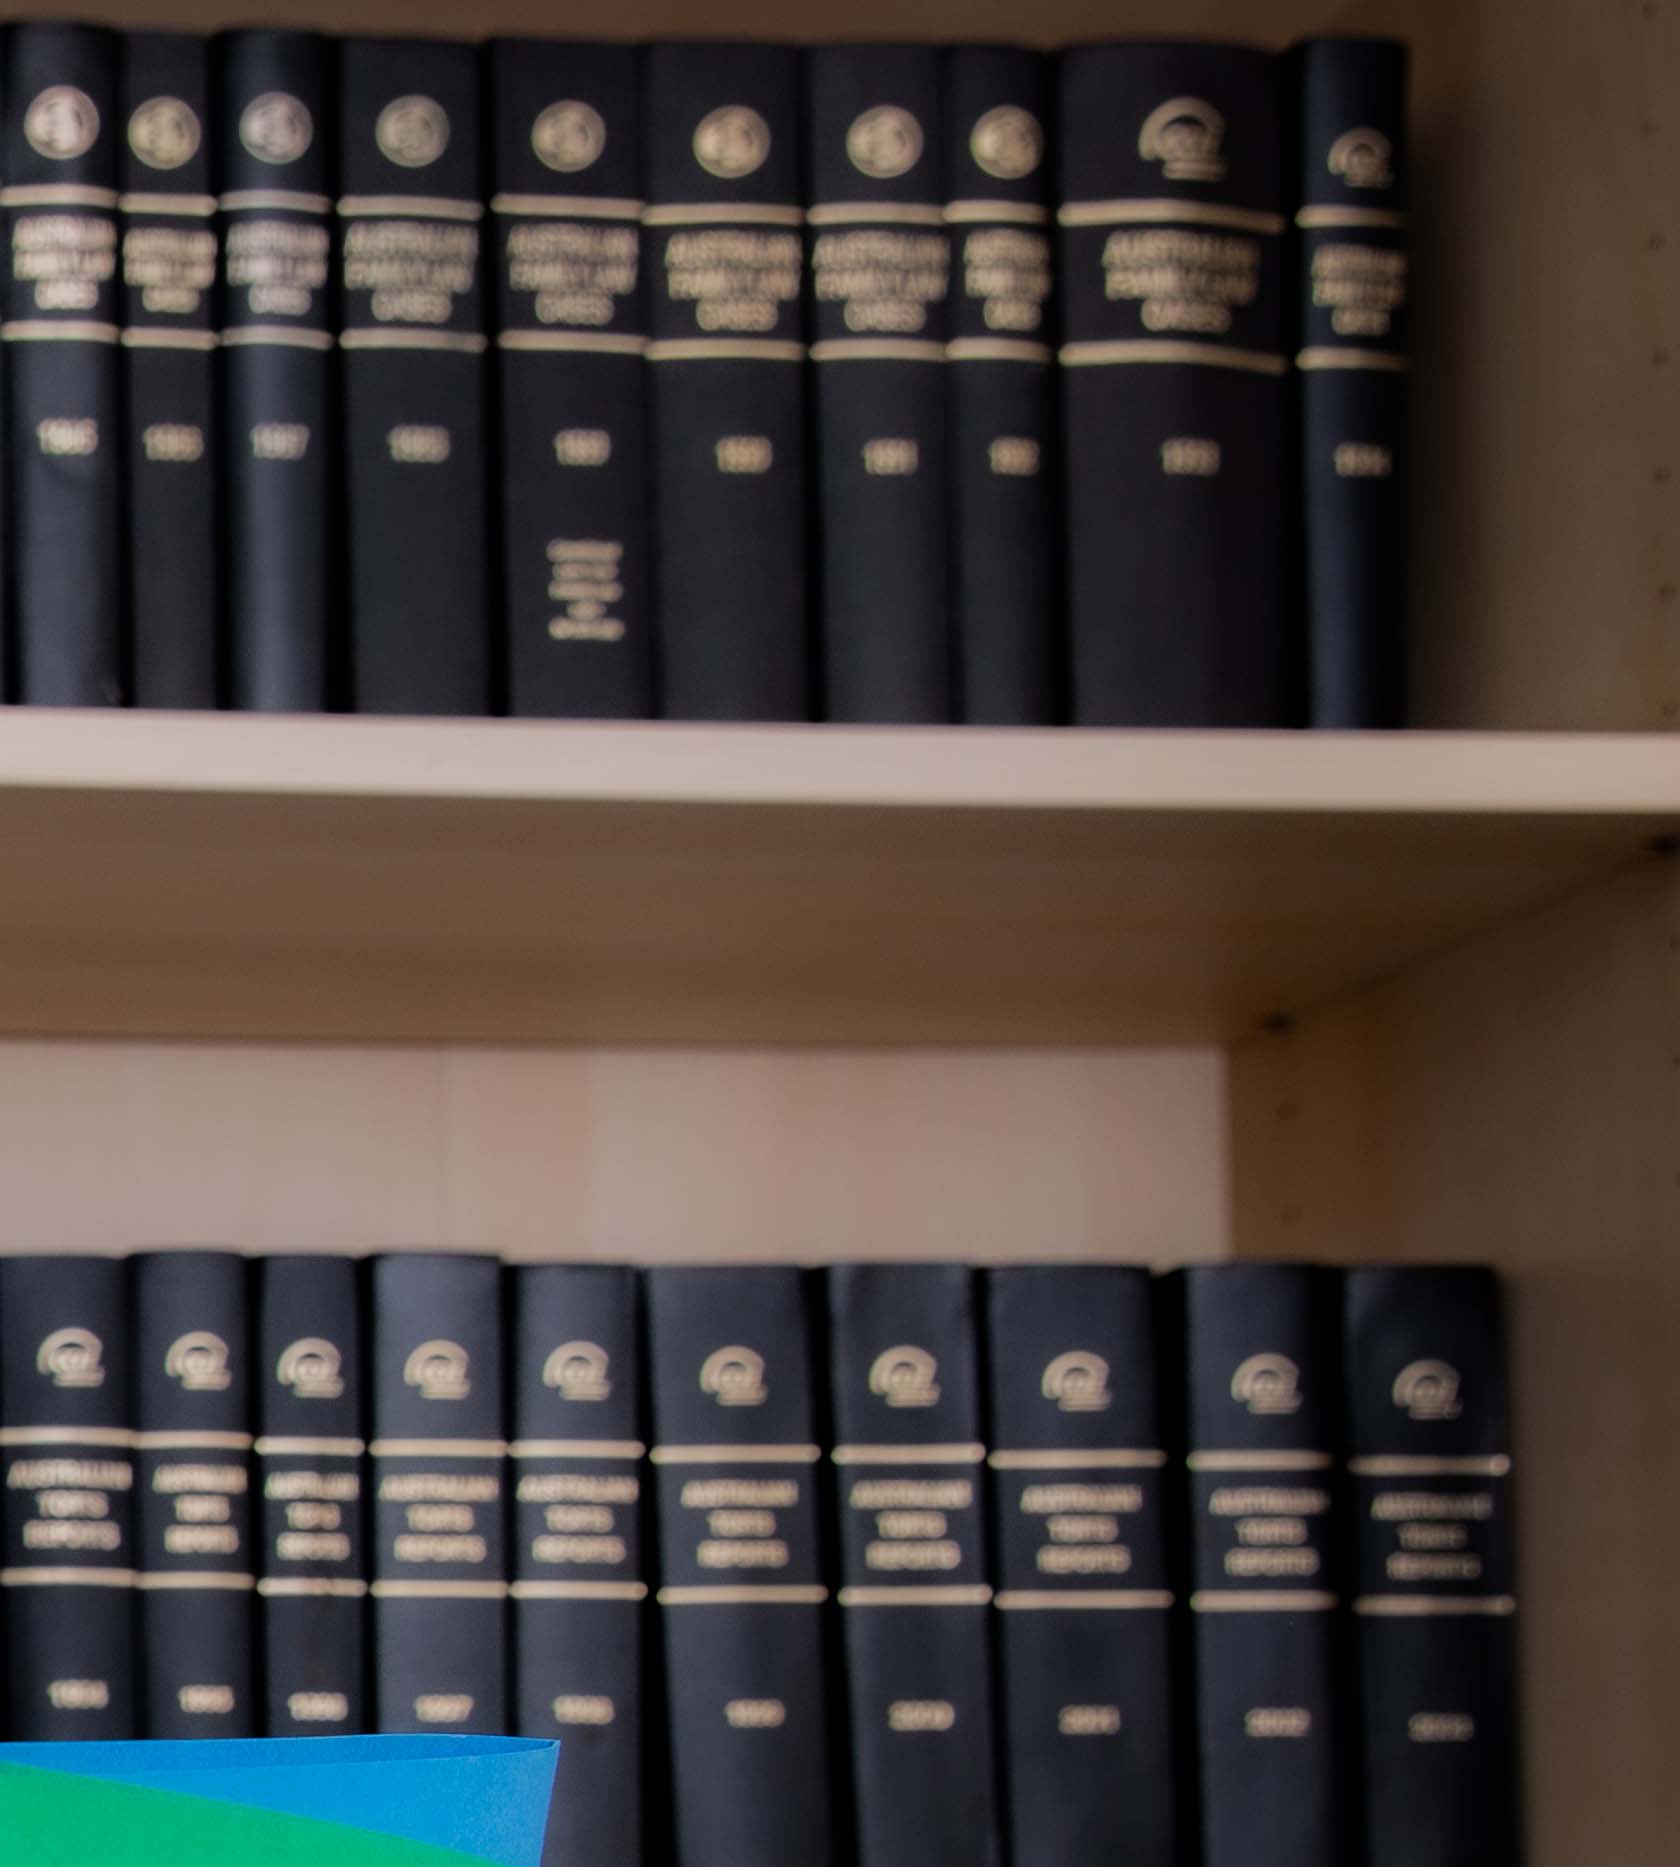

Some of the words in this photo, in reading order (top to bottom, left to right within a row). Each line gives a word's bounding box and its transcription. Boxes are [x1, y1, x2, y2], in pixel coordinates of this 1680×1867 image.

[7, 1460, 133, 1489] AUSTRALIAN
[153, 1464, 248, 1495] AUSTRALIAN
[264, 1473, 360, 1500] AUSTRALIAN
[379, 1473, 500, 1502] AUSTRALIAN
[516, 1474, 640, 1504] AUSTRALIAN
[38, 1490, 110, 1519] TORTS
[680, 1479, 799, 1508] AUSTRALIAN
[850, 1479, 972, 1509] AUSTRALIAN
[1020, 1483, 1143, 1513] AUSTRALIAN
[1209, 1487, 1331, 1516] AUSTRALIAN
[407, 1504, 474, 1532] TORTS
[545, 1505, 613, 1533] TORTS
[708, 1509, 776, 1537] TORTS
[875, 1511, 947, 1539] TORTS
[1047, 1515, 1119, 1543] TORTS
[1235, 1517, 1307, 1546] TORTS
[23, 1519, 121, 1549] REPORTS
[165, 1524, 239, 1554] REPORTS
[277, 1532, 350, 1561] REPORTS
[393, 1534, 486, 1563] REPORTS
[532, 1535, 625, 1563] REPORTS
[696, 1540, 789, 1568] REPORTS
[865, 1540, 961, 1569] REPORTS
[1036, 1544, 1131, 1573] REPORTS
[1224, 1547, 1320, 1576] REPORTS
[414, 1694, 474, 1722] 1997
